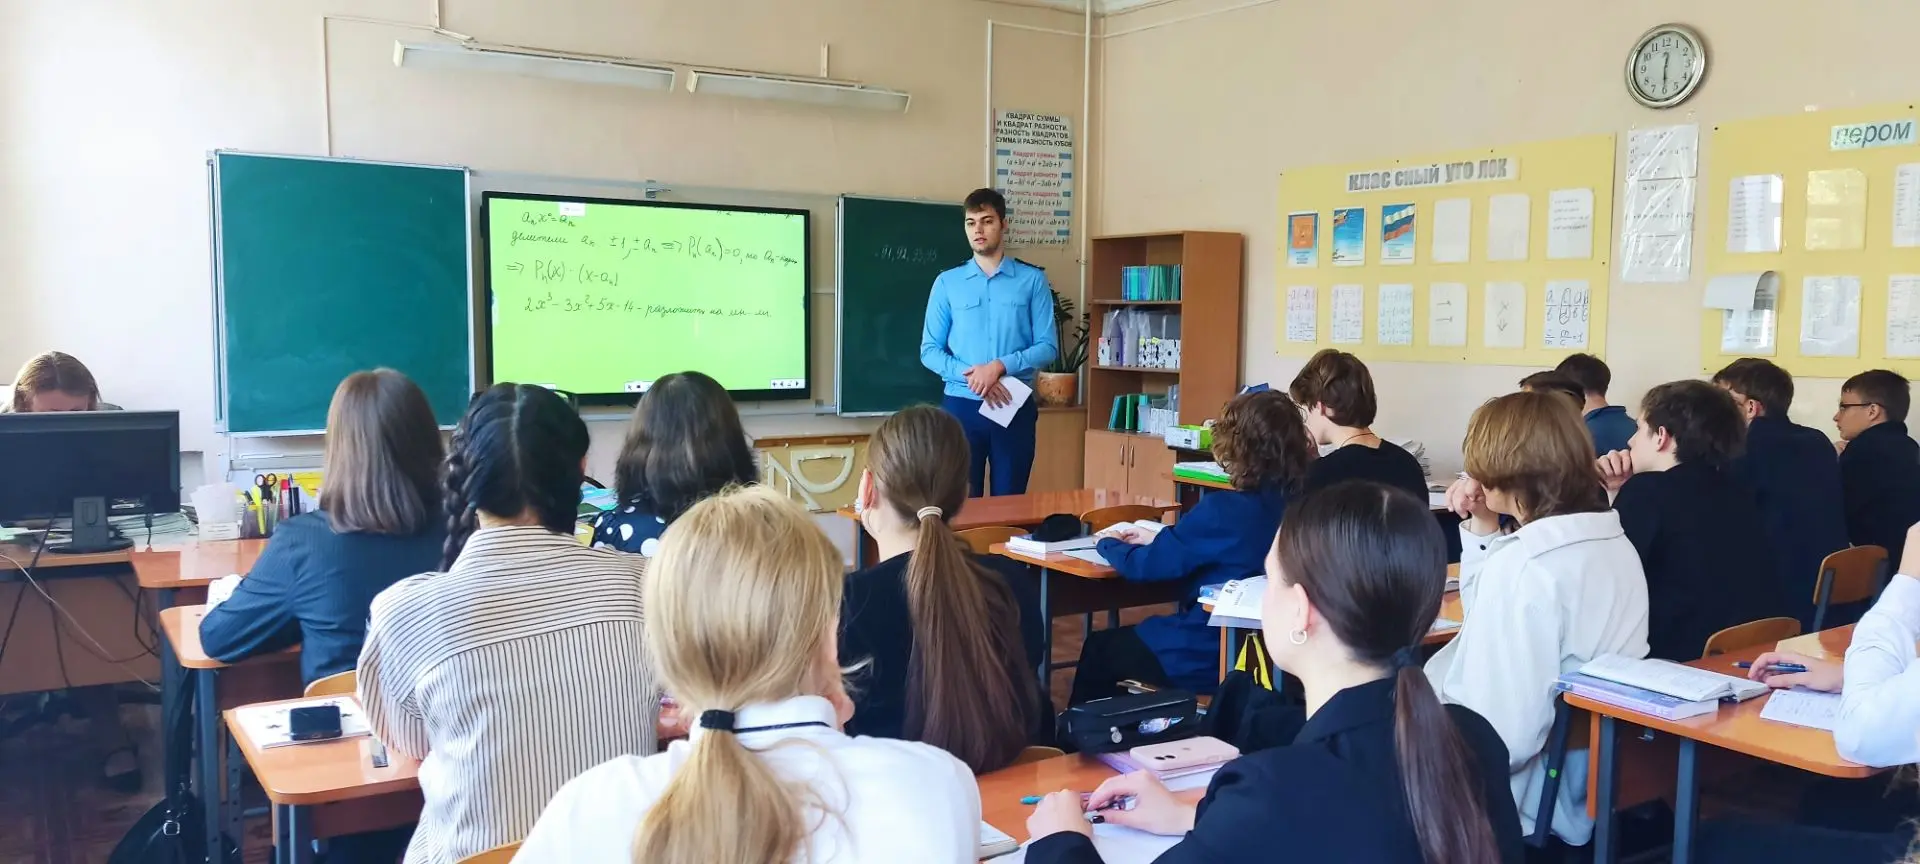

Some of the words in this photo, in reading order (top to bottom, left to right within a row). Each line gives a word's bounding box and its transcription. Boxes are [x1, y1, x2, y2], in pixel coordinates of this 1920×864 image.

[1662, 37, 1671, 47] 12
[1676, 40, 1679, 48] 1
[1652, 42, 1658, 52] 11
[1682, 47, 1688, 56] 2
[1644, 52, 1652, 61] 10
[1640, 65, 1646, 74] 9
[1680, 72, 1686, 80] 4
[1644, 77, 1650, 85] 8
[1651, 84, 1656, 93] 7
[1662, 86, 1668, 94] 6
[1674, 82, 1678, 90] 5
[1006, 112, 1034, 120] КВАДРАТ
[1036, 114, 1060, 122] СУММЫ
[1004, 120, 1032, 128] КВАДРАТ
[996, 128, 1030, 136] РАЗНОСТЬ
